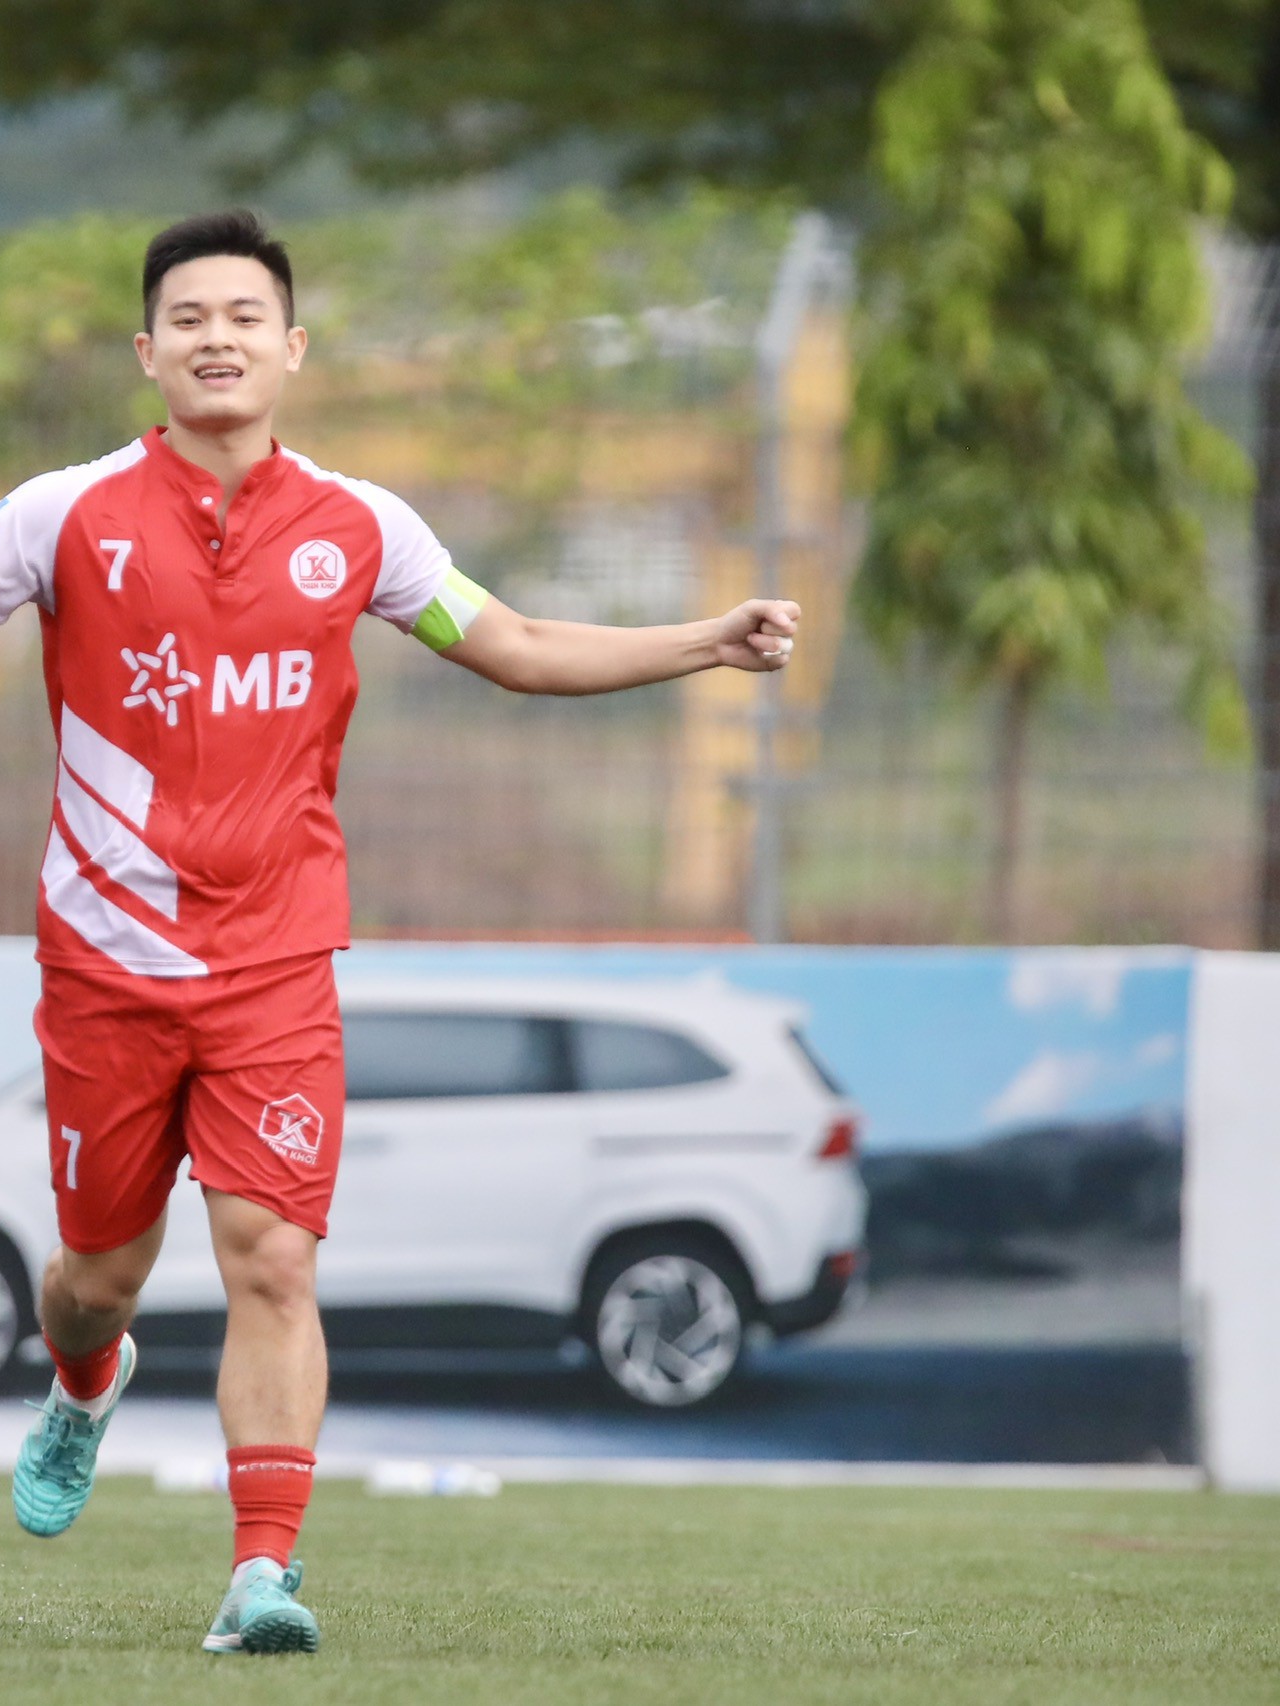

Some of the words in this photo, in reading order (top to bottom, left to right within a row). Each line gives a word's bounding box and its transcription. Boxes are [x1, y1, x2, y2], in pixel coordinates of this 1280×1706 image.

[99, 539, 133, 590] 7
[212, 649, 313, 713] MB
[61, 1124, 81, 1189] 7
